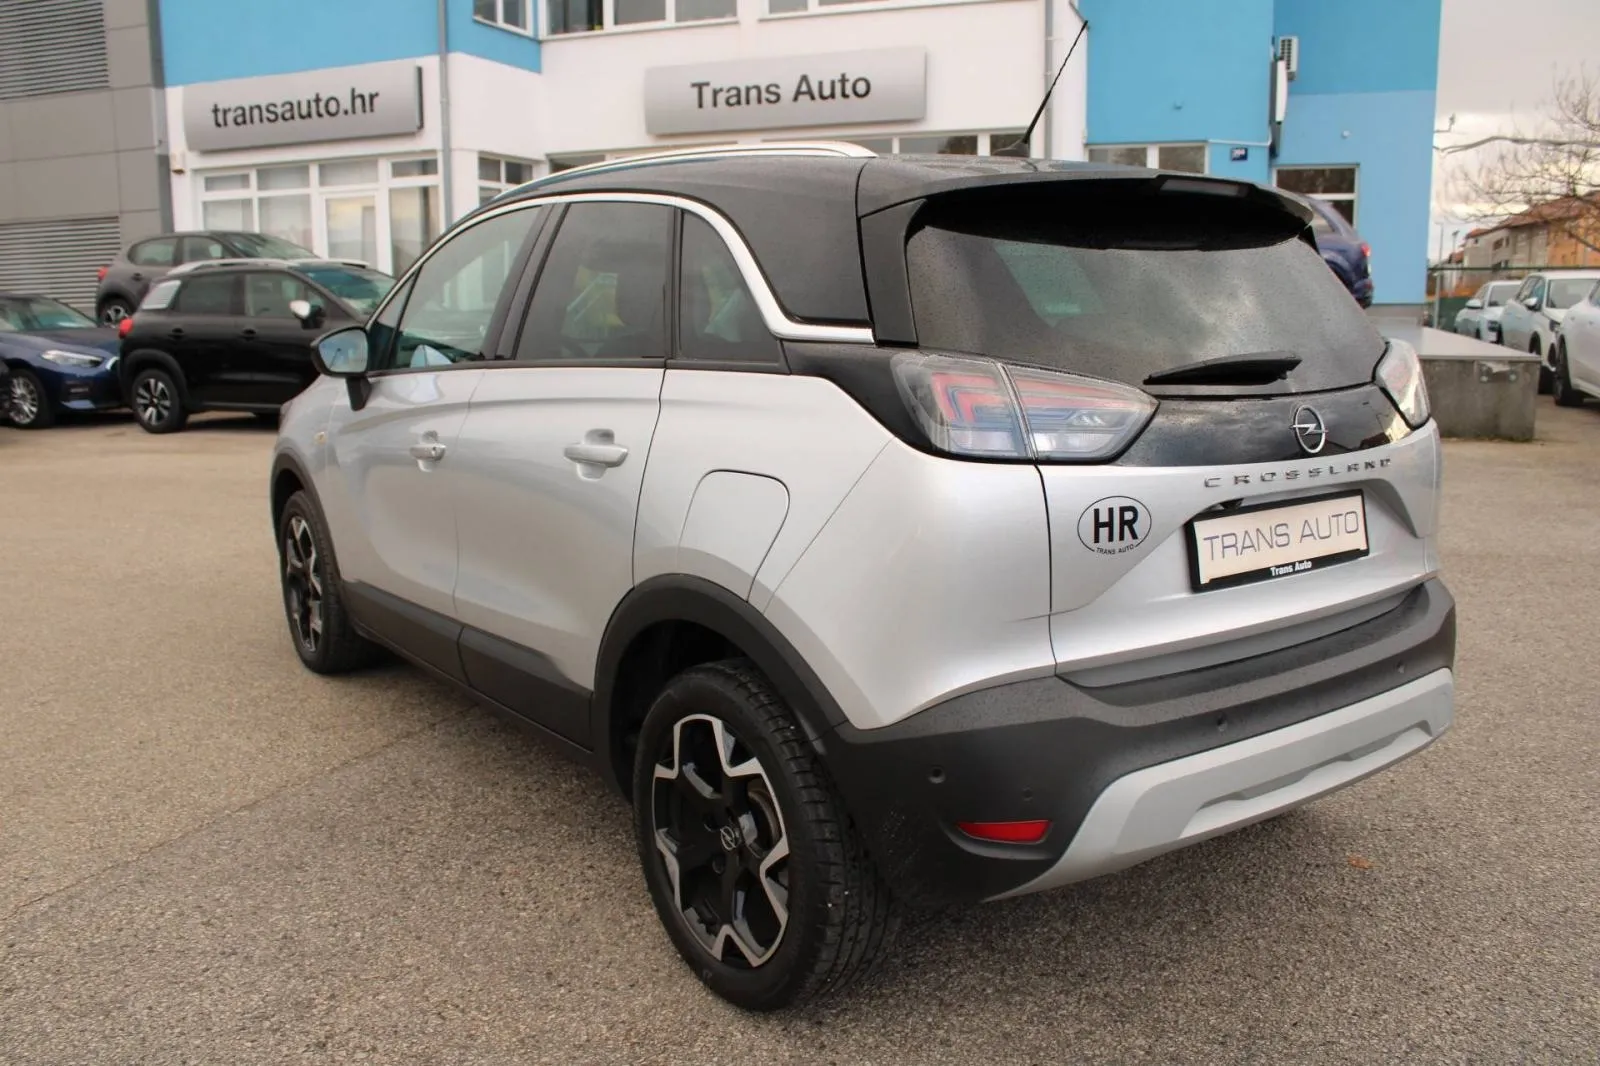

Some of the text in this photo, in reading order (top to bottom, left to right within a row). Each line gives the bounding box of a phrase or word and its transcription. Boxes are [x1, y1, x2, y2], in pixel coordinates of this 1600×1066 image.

[211, 87, 379, 128] transauto.hr
[690, 72, 871, 109] Trans Auto
[1203, 458, 1391, 489] CROSSLAND
[1093, 505, 1139, 544] HR
[1203, 510, 1360, 561] TRANS AUTO
[1096, 543, 1135, 556] TRANS AUTO
[1270, 559, 1313, 577] Trans Auto
